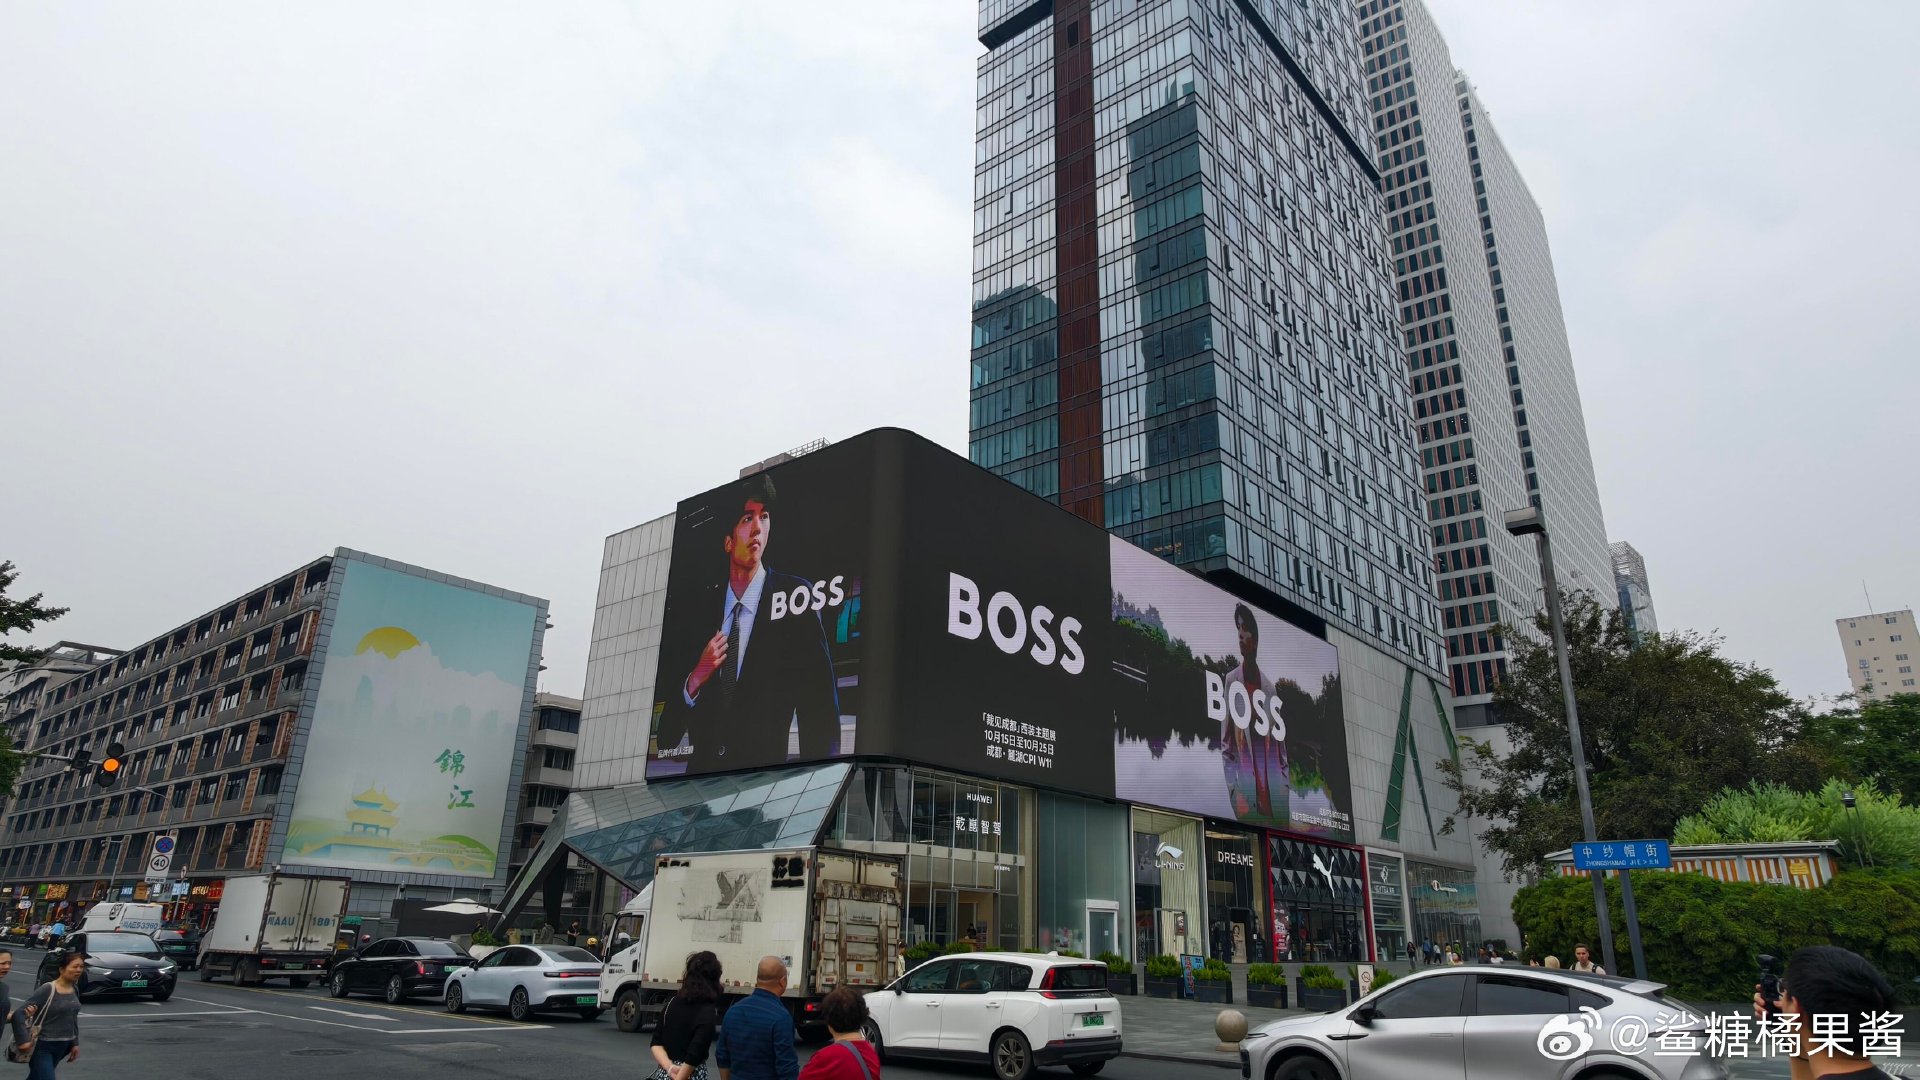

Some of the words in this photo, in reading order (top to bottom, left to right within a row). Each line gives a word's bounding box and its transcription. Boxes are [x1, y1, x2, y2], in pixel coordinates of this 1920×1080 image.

[771, 575, 844, 621] BOSS
[948, 571, 1085, 675] BOSS
[1205, 669, 1286, 741] BOSS
[984, 729, 1055, 756] 10月15日至10月25日
[1037, 755, 1052, 769] W11
[966, 792, 993, 804] HUAWEI
[1217, 850, 1254, 867] DREAME
[1582, 843, 1658, 859] 中纱帽街
[153, 858, 166, 868] 40
[1154, 859, 1185, 871] LI-NING
